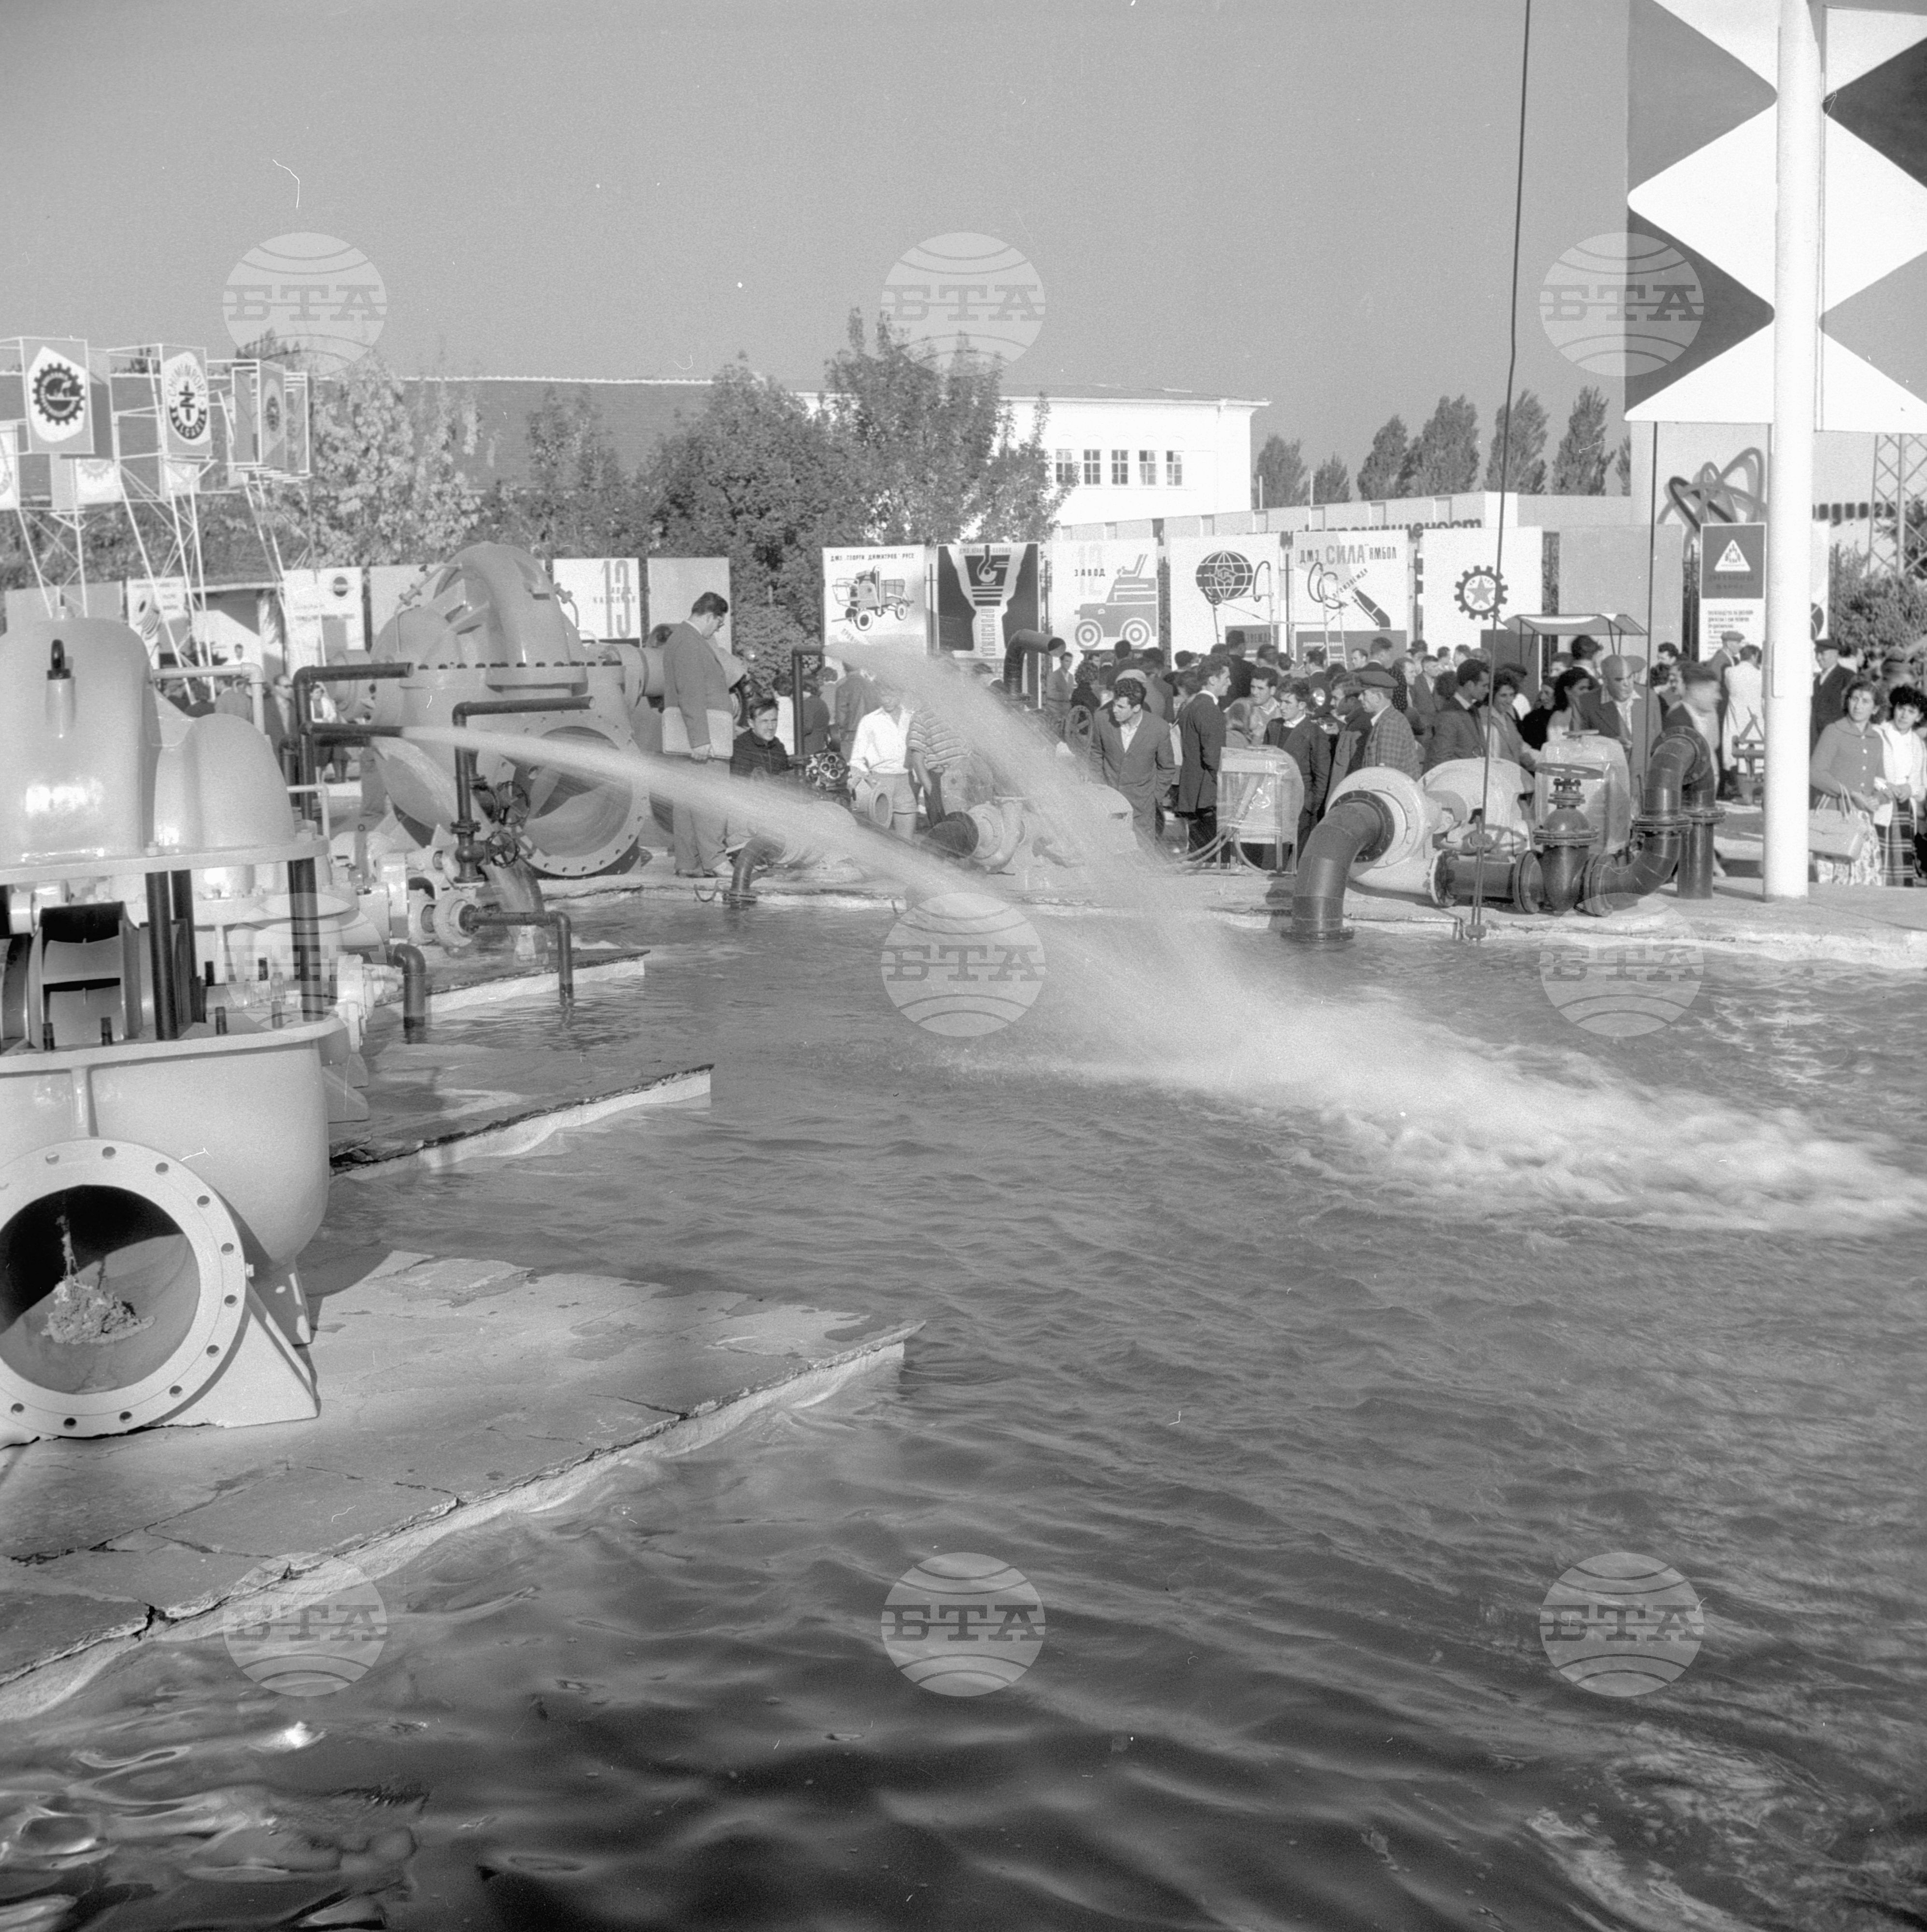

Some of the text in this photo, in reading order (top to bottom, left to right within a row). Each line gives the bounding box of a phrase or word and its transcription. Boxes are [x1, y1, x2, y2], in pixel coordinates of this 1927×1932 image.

[1300, 549, 1319, 564] ДМЗ
[1369, 546, 1397, 560] ЯМБОЛ
[1074, 568, 1106, 577] ЗАВОД
[980, 609, 996, 657] ПРОИЗВЕЖДА
